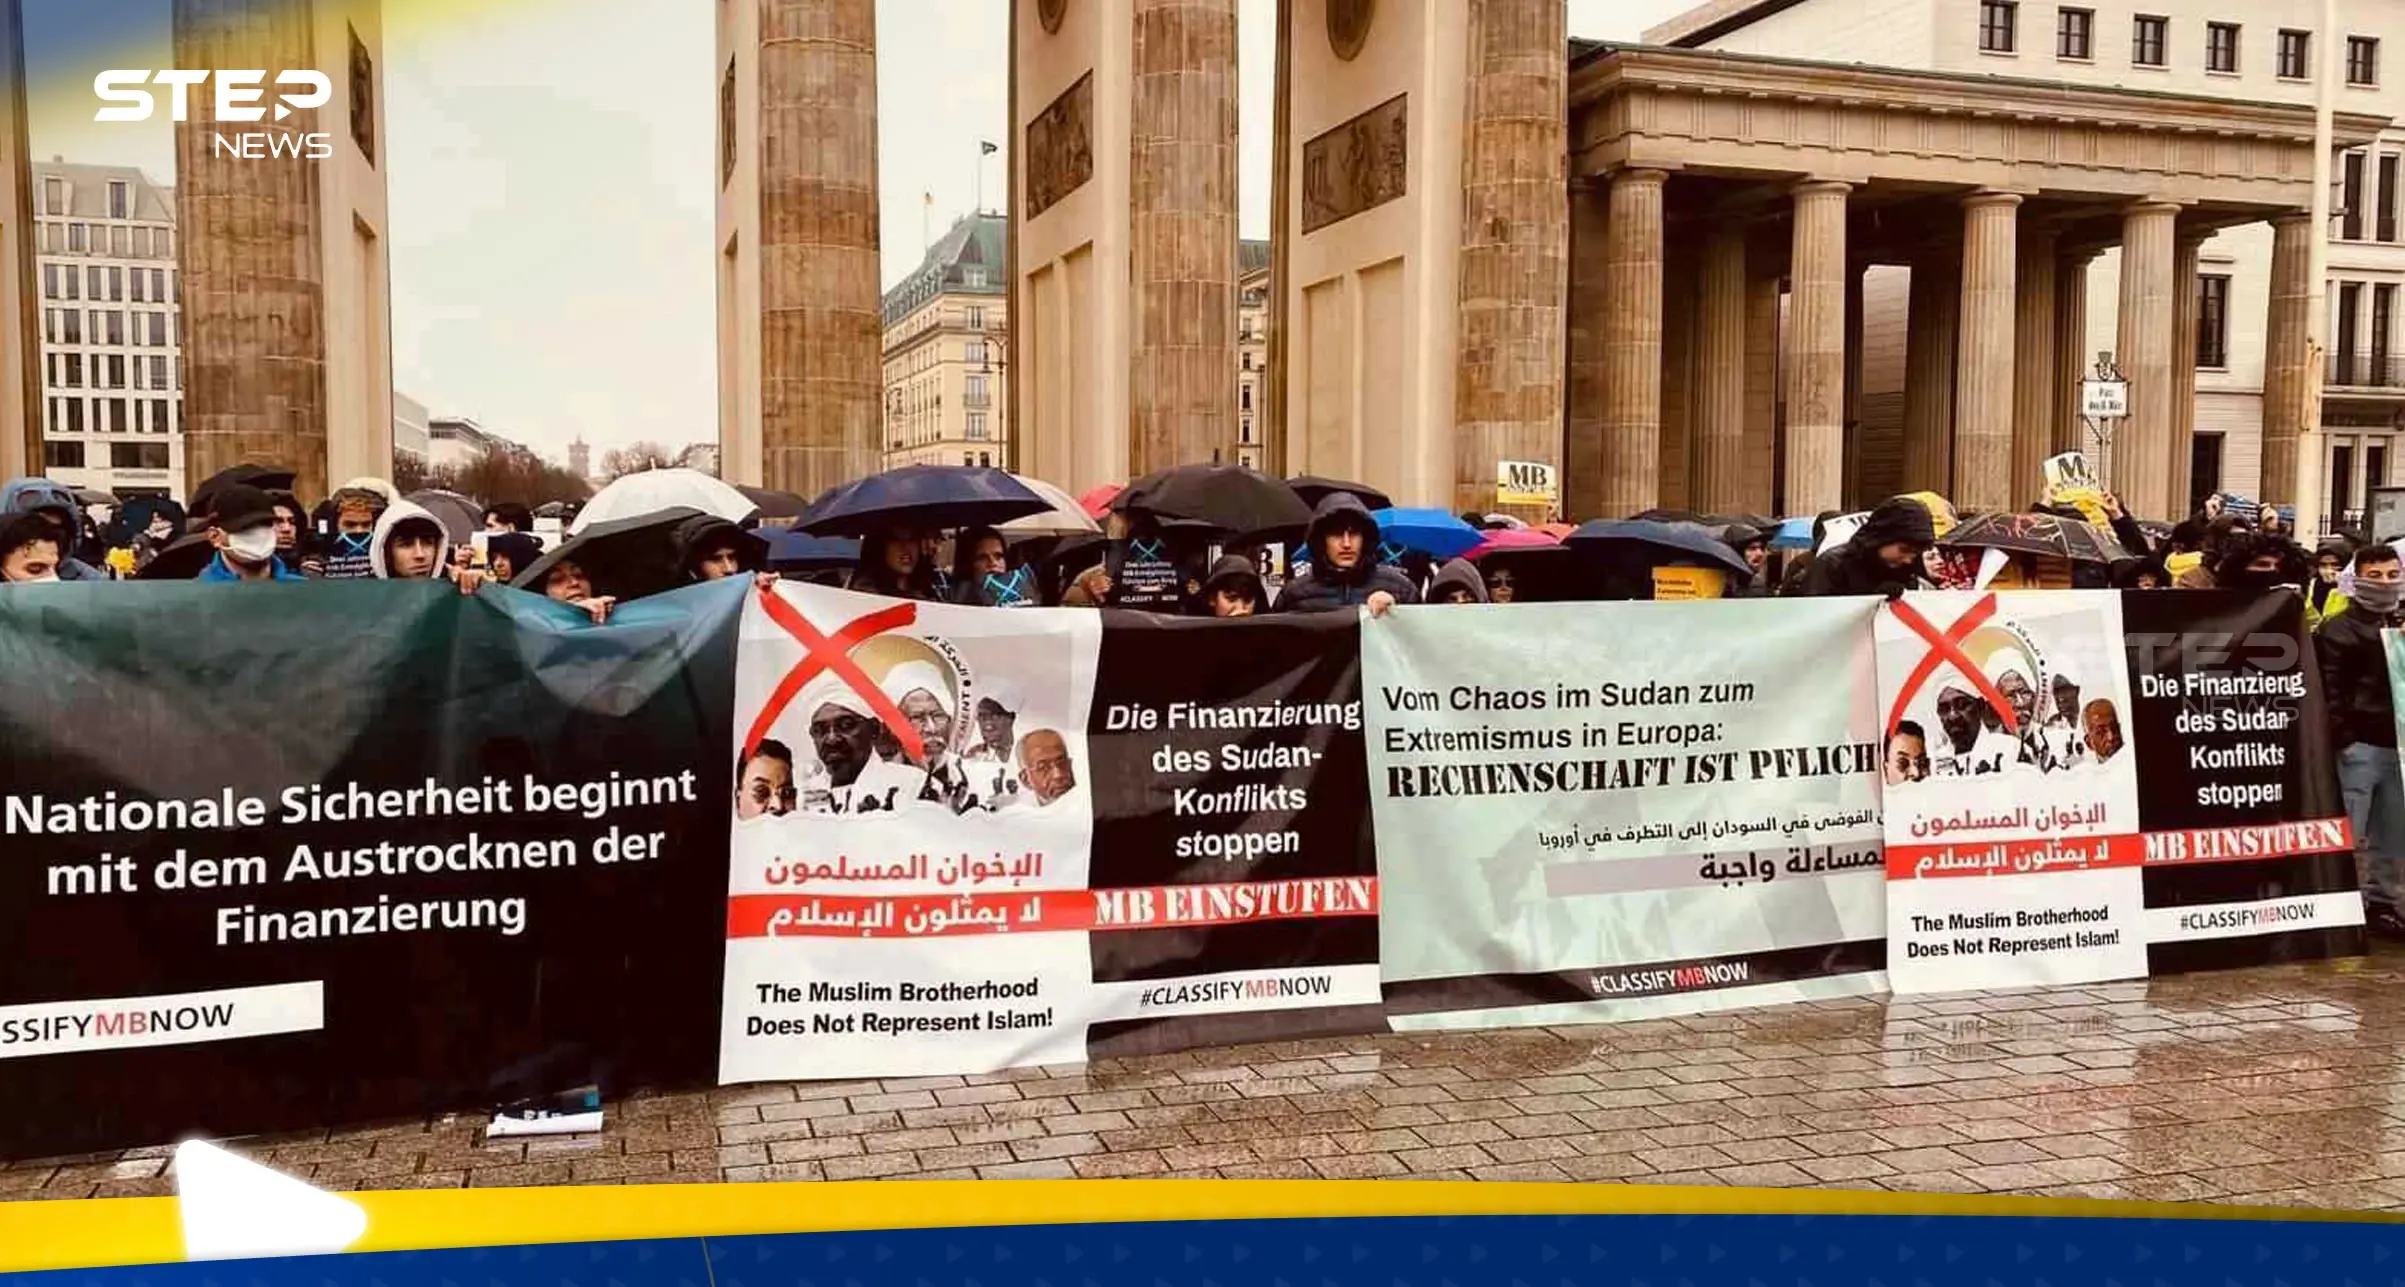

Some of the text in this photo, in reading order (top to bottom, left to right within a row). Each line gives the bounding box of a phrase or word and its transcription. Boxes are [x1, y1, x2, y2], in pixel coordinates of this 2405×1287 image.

[1509, 464, 1547, 489] MB
[1382, 680, 1755, 711] Vom Chaos im Sudan zum
[2140, 673, 2179, 698] Die
[1106, 700, 1361, 731] Die Finanzierung
[2175, 708, 2216, 733] des
[1385, 722, 1723, 752] Extremismus in Europa:
[1152, 742, 1322, 773] des Sudan-
[1387, 742, 1881, 797] RECHENSCHAFT IST PFLICH
[2190, 742, 2285, 769] Konflikts
[5, 769, 697, 834] Nationale Sicherheit beginnt
[1174, 784, 1308, 817] Konflikts
[2197, 782, 2283, 809] stoppen
[1678, 820, 1708, 840] إلى
[1712, 816, 1778, 838] السودان
[1782, 814, 1809, 838] في
[1814, 809, 1873, 831] الفوضى
[1911, 807, 2028, 837] المسلمون
[2035, 802, 2106, 832] الإخوان
[1176, 830, 1300, 861] stoppen
[1539, 823, 1579, 850] أوروبا
[1584, 827, 1612, 851] في
[1617, 823, 1673, 842] التطرف
[2144, 832, 2187, 862] MB
[48, 826, 665, 895] mit dem Austrocknen der
[765, 853, 1043, 886] الإخوان المسلمون
[1700, 851, 1775, 888] واجبة
[1914, 835, 2110, 879] لا يمثلون الإسلام
[767, 891, 1041, 938] لا يمثلون الإسلام
[1093, 877, 1374, 926] MB EINSTUFEN
[2180, 902, 2315, 930] #CLASSIFYMBNOW
[216, 895, 526, 945] Finanzierung
[1911, 905, 2108, 932] The Muslim Brotherhood
[1907, 929, 2120, 958] Does Not Represent Islam!
[756, 977, 1039, 1004] The Muslim Brotherhood
[1140, 975, 1332, 1008] #CLASSIFYMBNOW
[1591, 962, 1748, 993] #CLASSIFYMBNOW
[747, 1007, 1053, 1036] Does Not Represent Islam!
